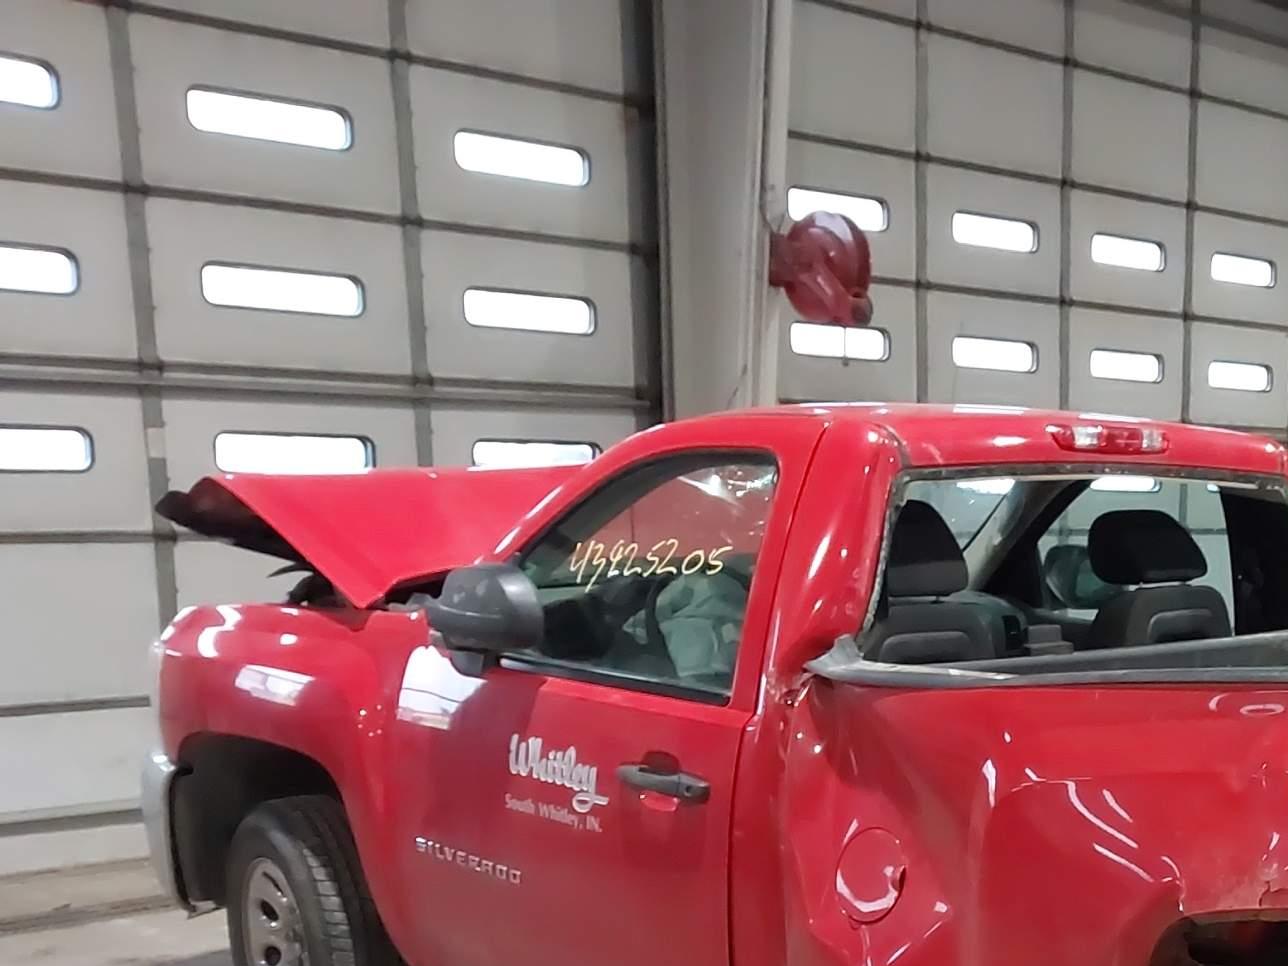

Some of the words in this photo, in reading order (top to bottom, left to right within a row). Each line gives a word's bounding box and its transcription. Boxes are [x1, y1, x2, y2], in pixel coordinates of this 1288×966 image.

[508, 733, 610, 814] Whitley
[504, 793, 536, 815] South
[415, 836, 522, 885] SILVERADO
